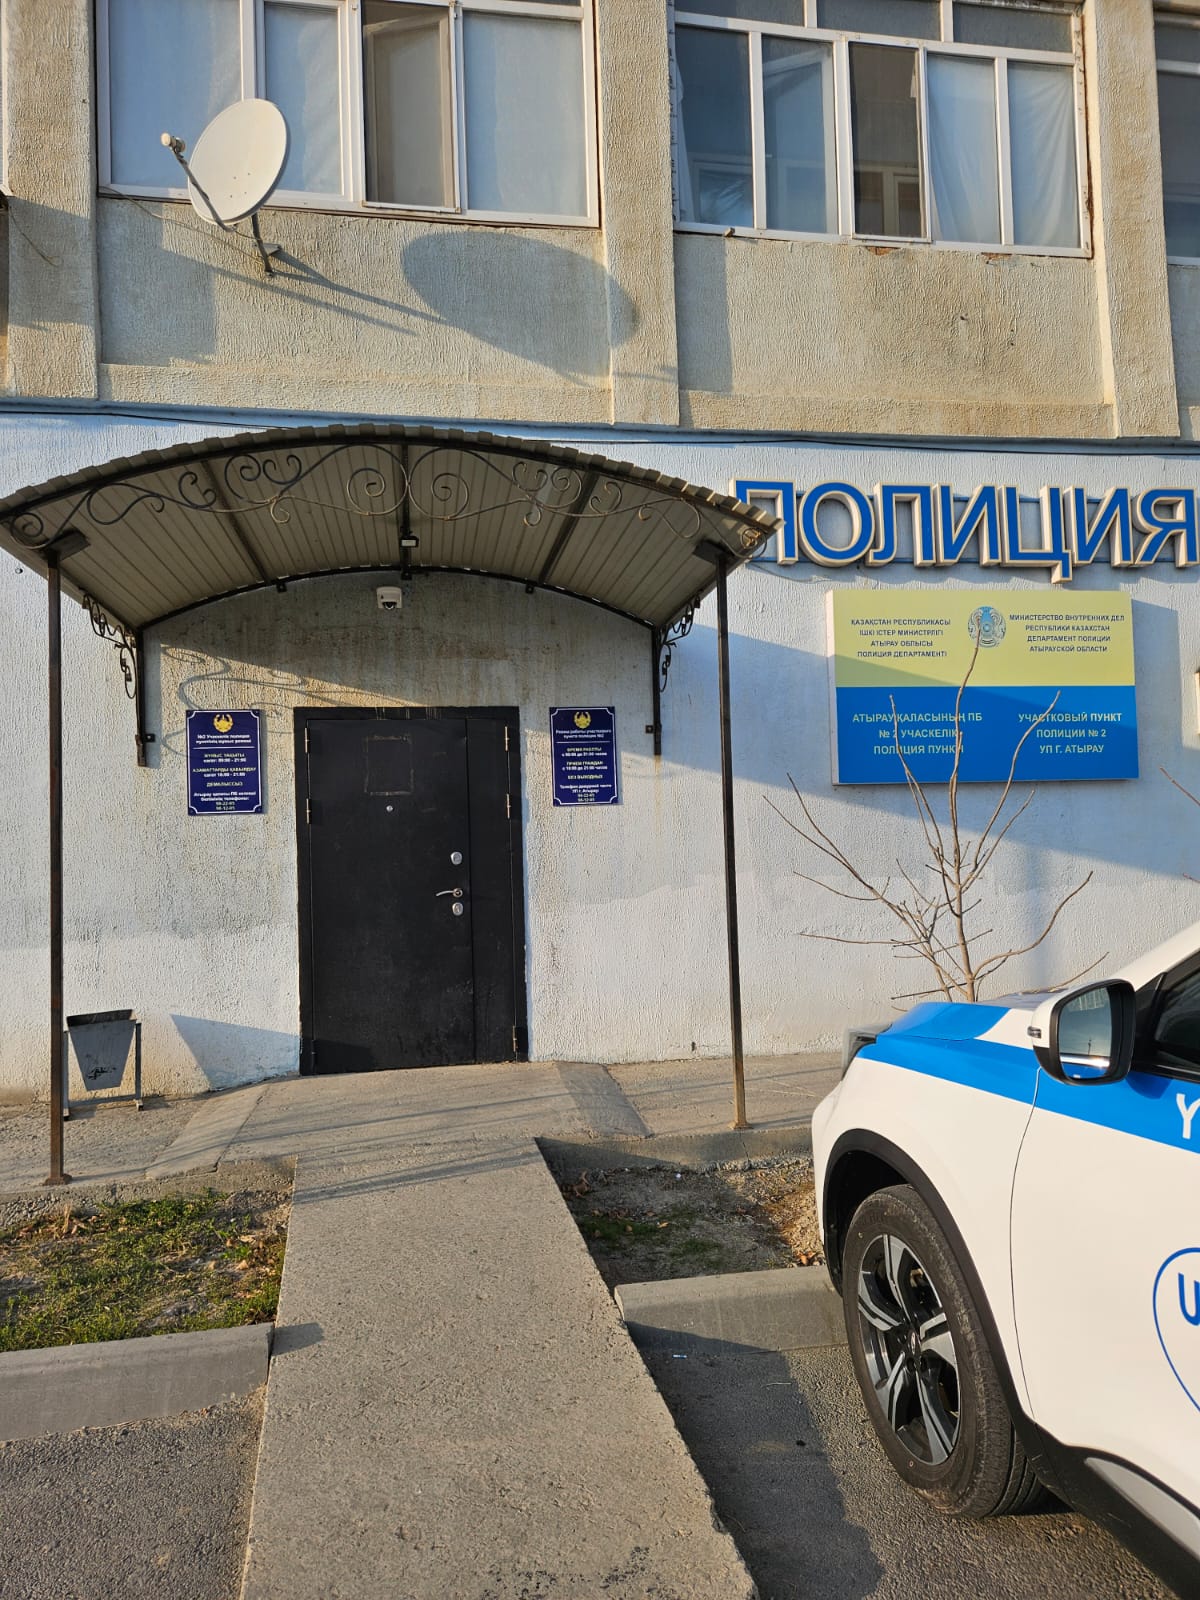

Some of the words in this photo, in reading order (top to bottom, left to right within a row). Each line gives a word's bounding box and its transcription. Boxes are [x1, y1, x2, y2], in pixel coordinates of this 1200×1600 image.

[729, 477, 1199, 583] ПОЛИЦИЯ
[852, 713, 894, 722] АТЫРАУ
[968, 712, 983, 721] ПБ
[1018, 712, 1088, 722] УЧАСТКОВЫЙ
[1090, 712, 1122, 722] ПУНКТ
[879, 729, 890, 738] №
[1036, 729, 1086, 739] ПОЛИЦИИ
[1088, 729, 1098, 737] №
[1101, 729, 1107, 737] 2
[874, 745, 925, 755] ПОЛИЦИЯ
[1039, 745, 1052, 753] УП
[1055, 745, 1062, 754] Г.
[1065, 744, 1104, 753] АТЫРАУ
